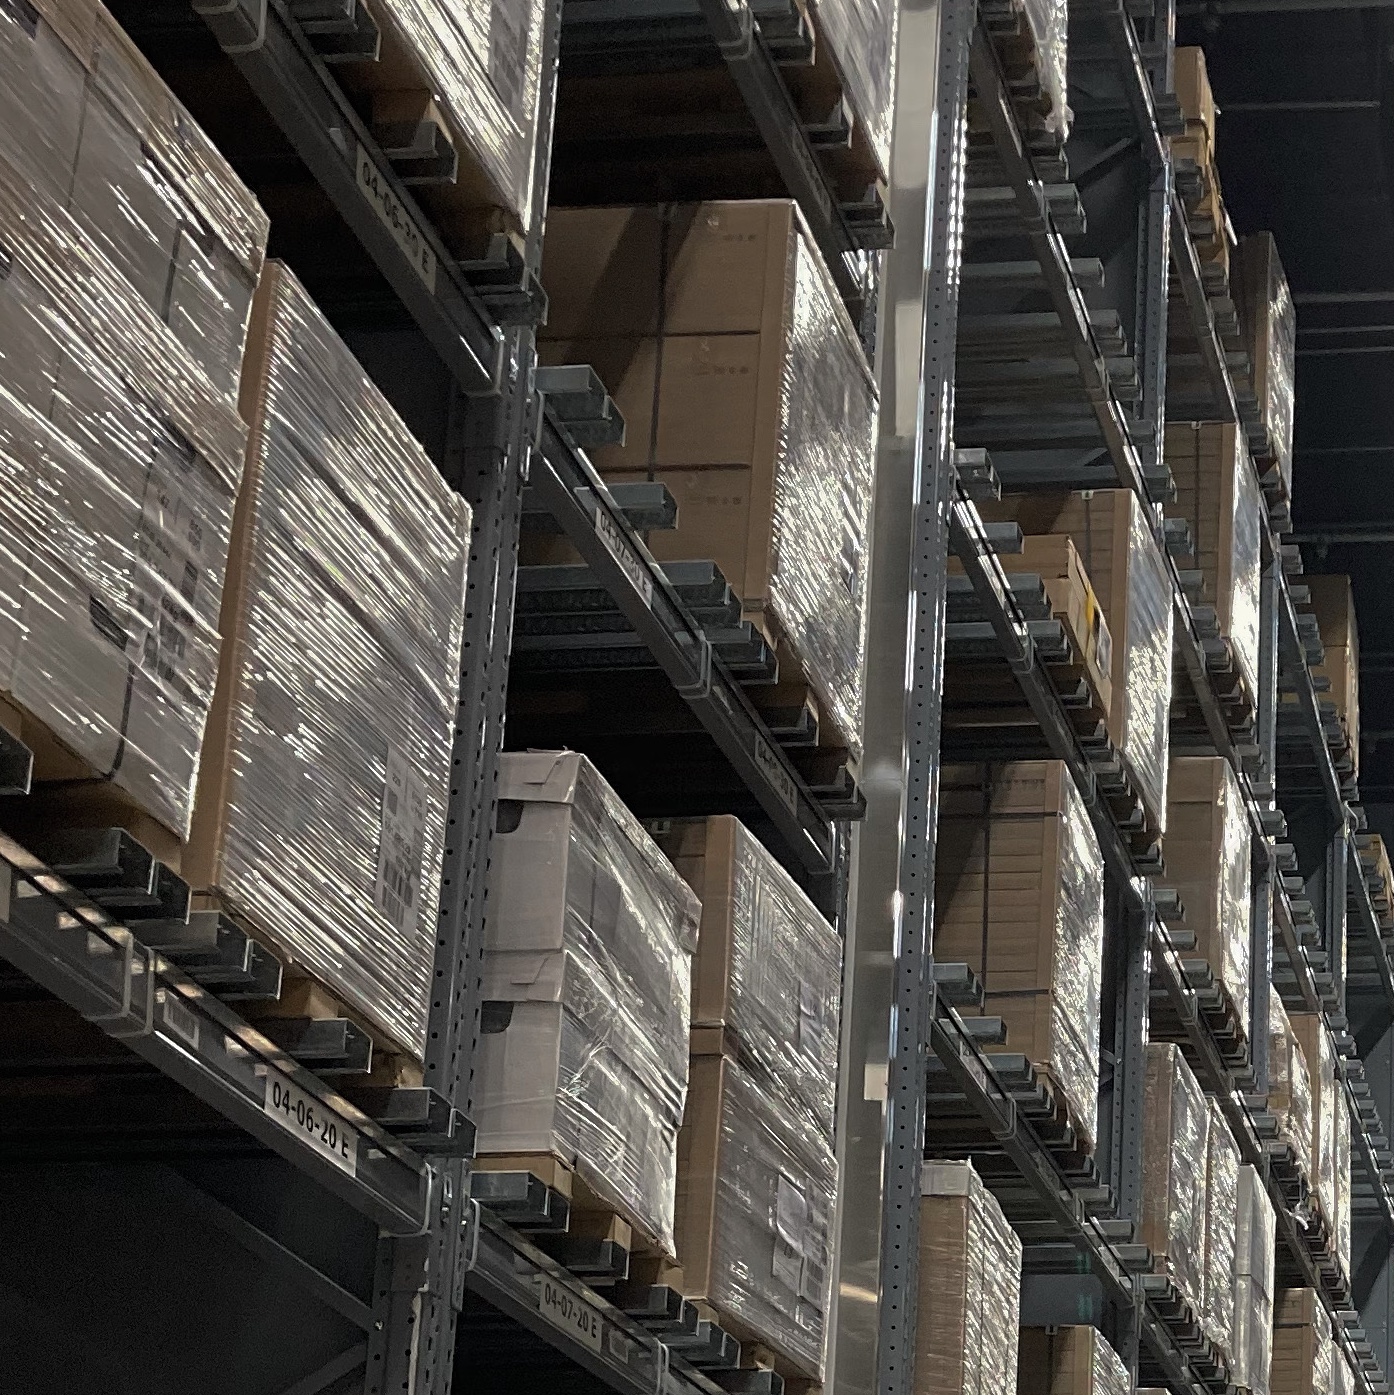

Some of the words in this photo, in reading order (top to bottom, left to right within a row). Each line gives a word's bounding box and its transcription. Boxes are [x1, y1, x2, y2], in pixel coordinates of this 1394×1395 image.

[272, 1081, 338, 1150] 04-06-20
[340, 1131, 350, 1159] E
[544, 1282, 589, 1333] 04-07-20
